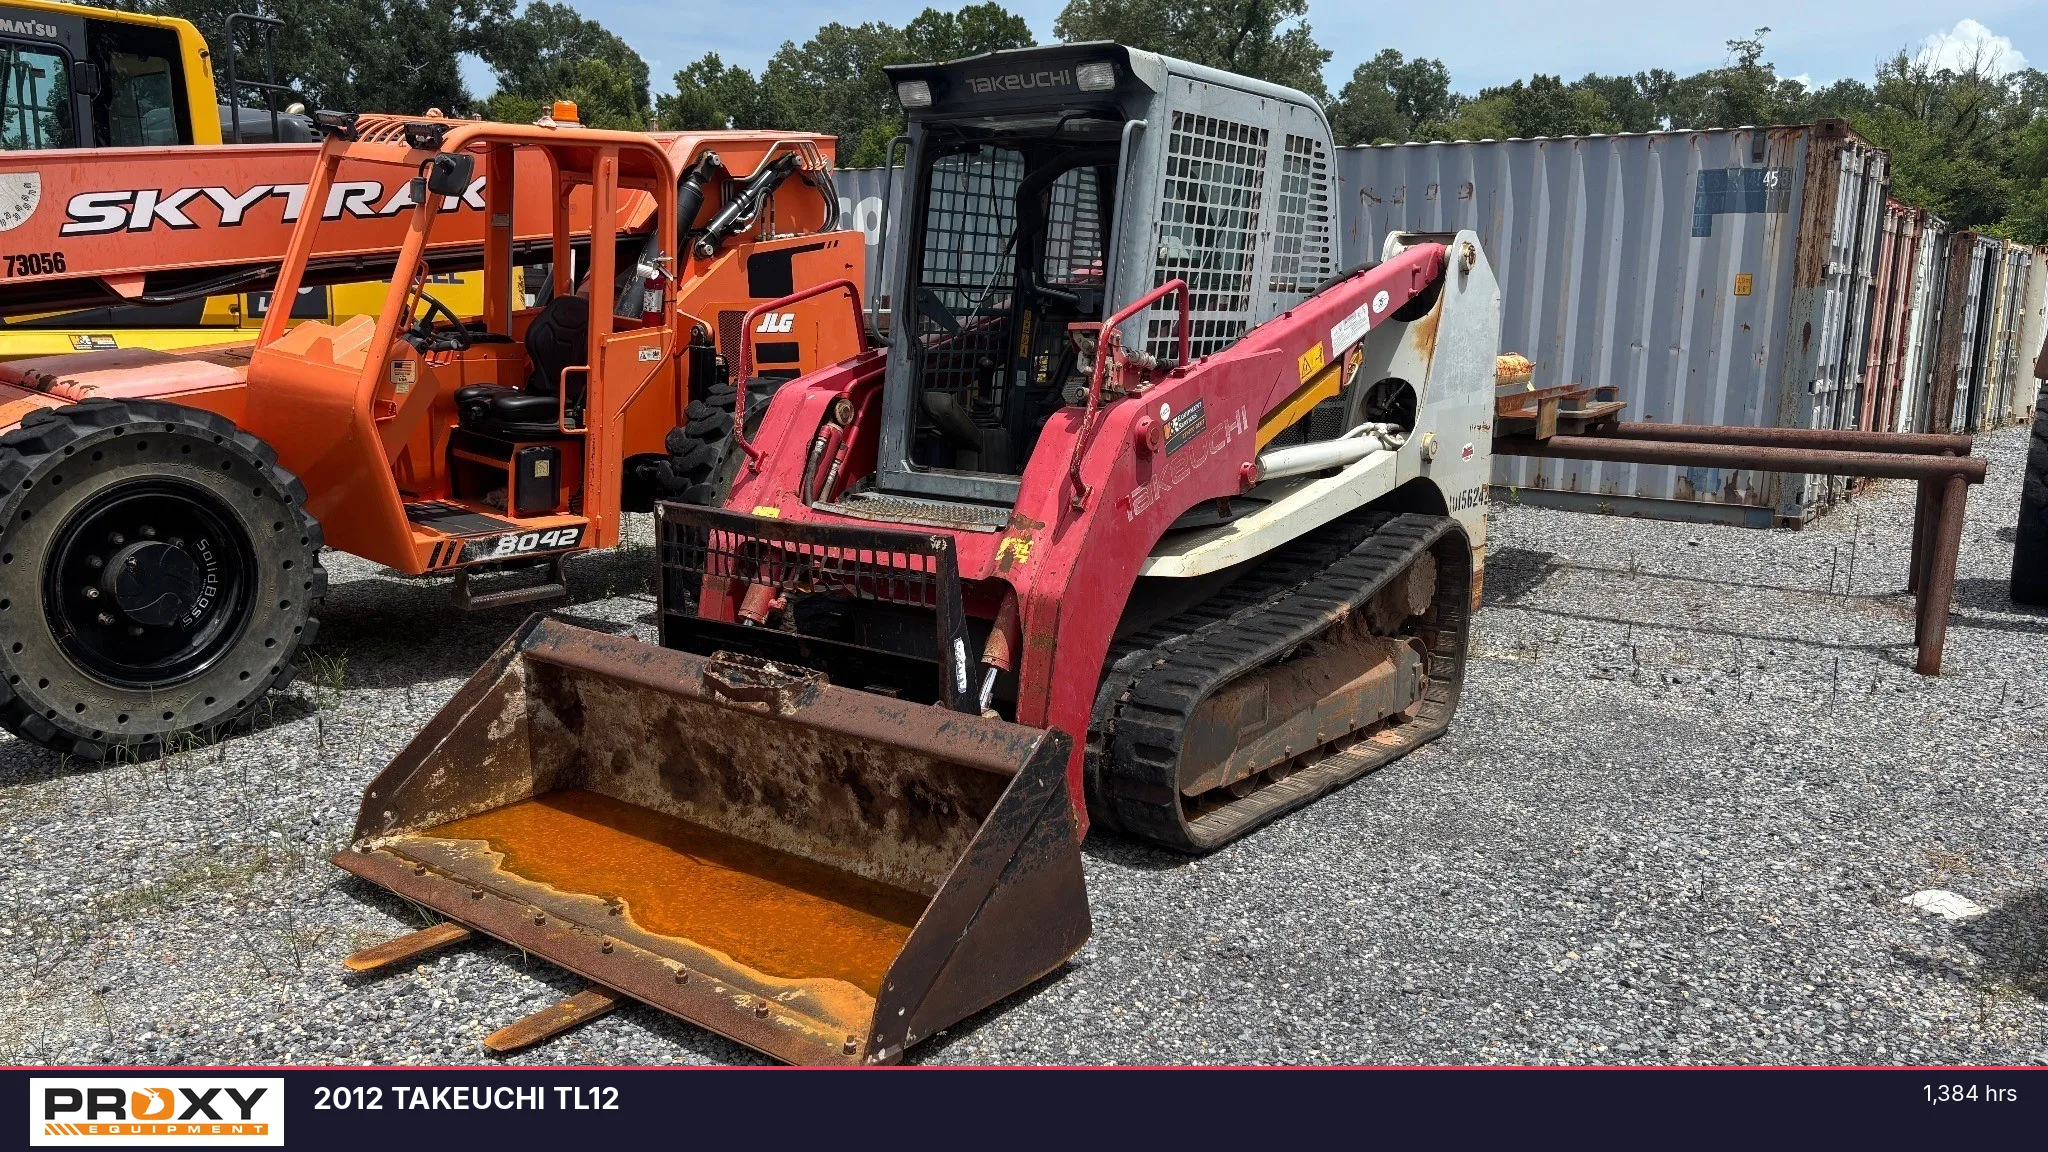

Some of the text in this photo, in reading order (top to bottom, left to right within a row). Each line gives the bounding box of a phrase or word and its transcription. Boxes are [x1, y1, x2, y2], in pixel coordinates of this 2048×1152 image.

[58, 176, 487, 237] SKYTRAK
[3, 252, 66, 277] 73056
[755, 312, 795, 333] JLG
[496, 528, 579, 554] 8042
